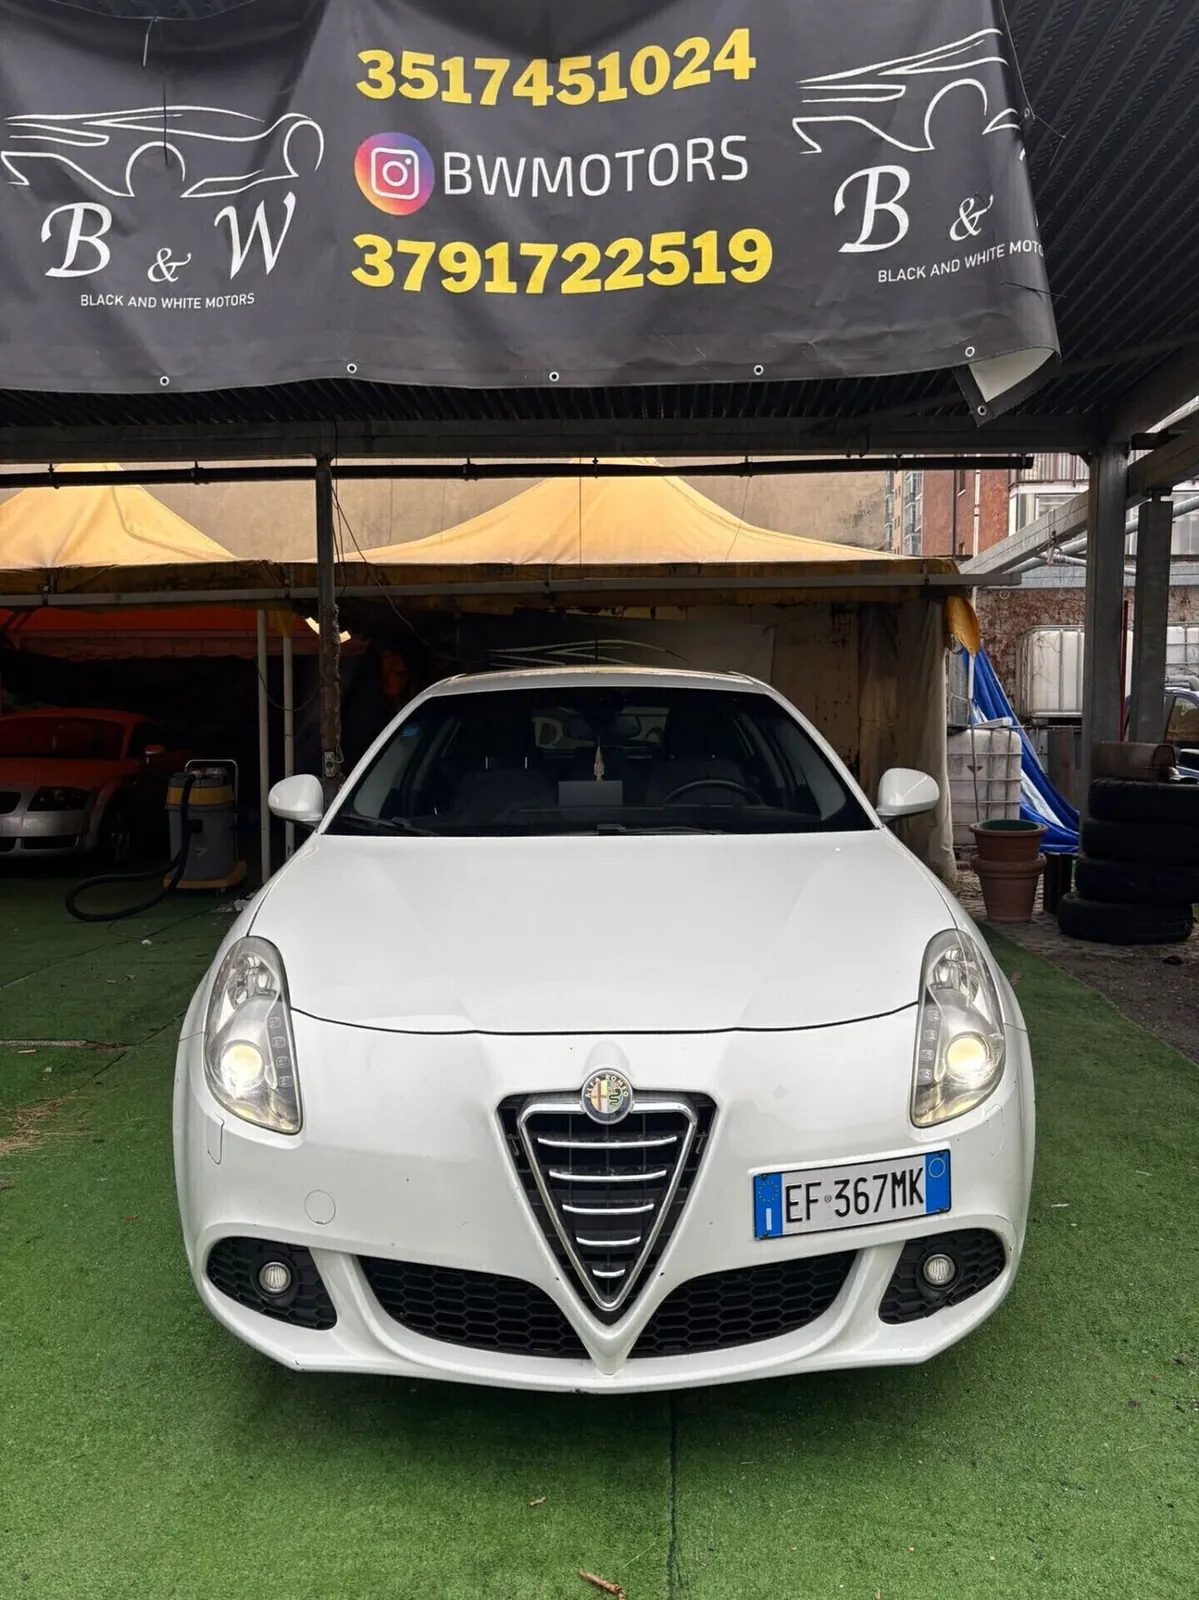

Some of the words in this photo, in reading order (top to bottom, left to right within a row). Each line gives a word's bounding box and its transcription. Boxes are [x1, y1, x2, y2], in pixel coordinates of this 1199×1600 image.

[356, 28, 757, 107] 3517451024
[444, 135, 749, 198] BWMOTORS
[40, 201, 113, 279] B
[147, 247, 192, 283] &
[213, 191, 296, 280] W
[835, 164, 911, 253] B
[949, 194, 994, 242] &
[351, 228, 773, 294] 3791722519
[878, 265, 926, 283] BLACK
[930, 259, 961, 277] AND
[964, 243, 1005, 269] WHITE
[80, 294, 124, 307] BLACK
[127, 296, 157, 309] AND
[161, 297, 202, 309] WHITE
[205, 292, 255, 309] MOTORS
